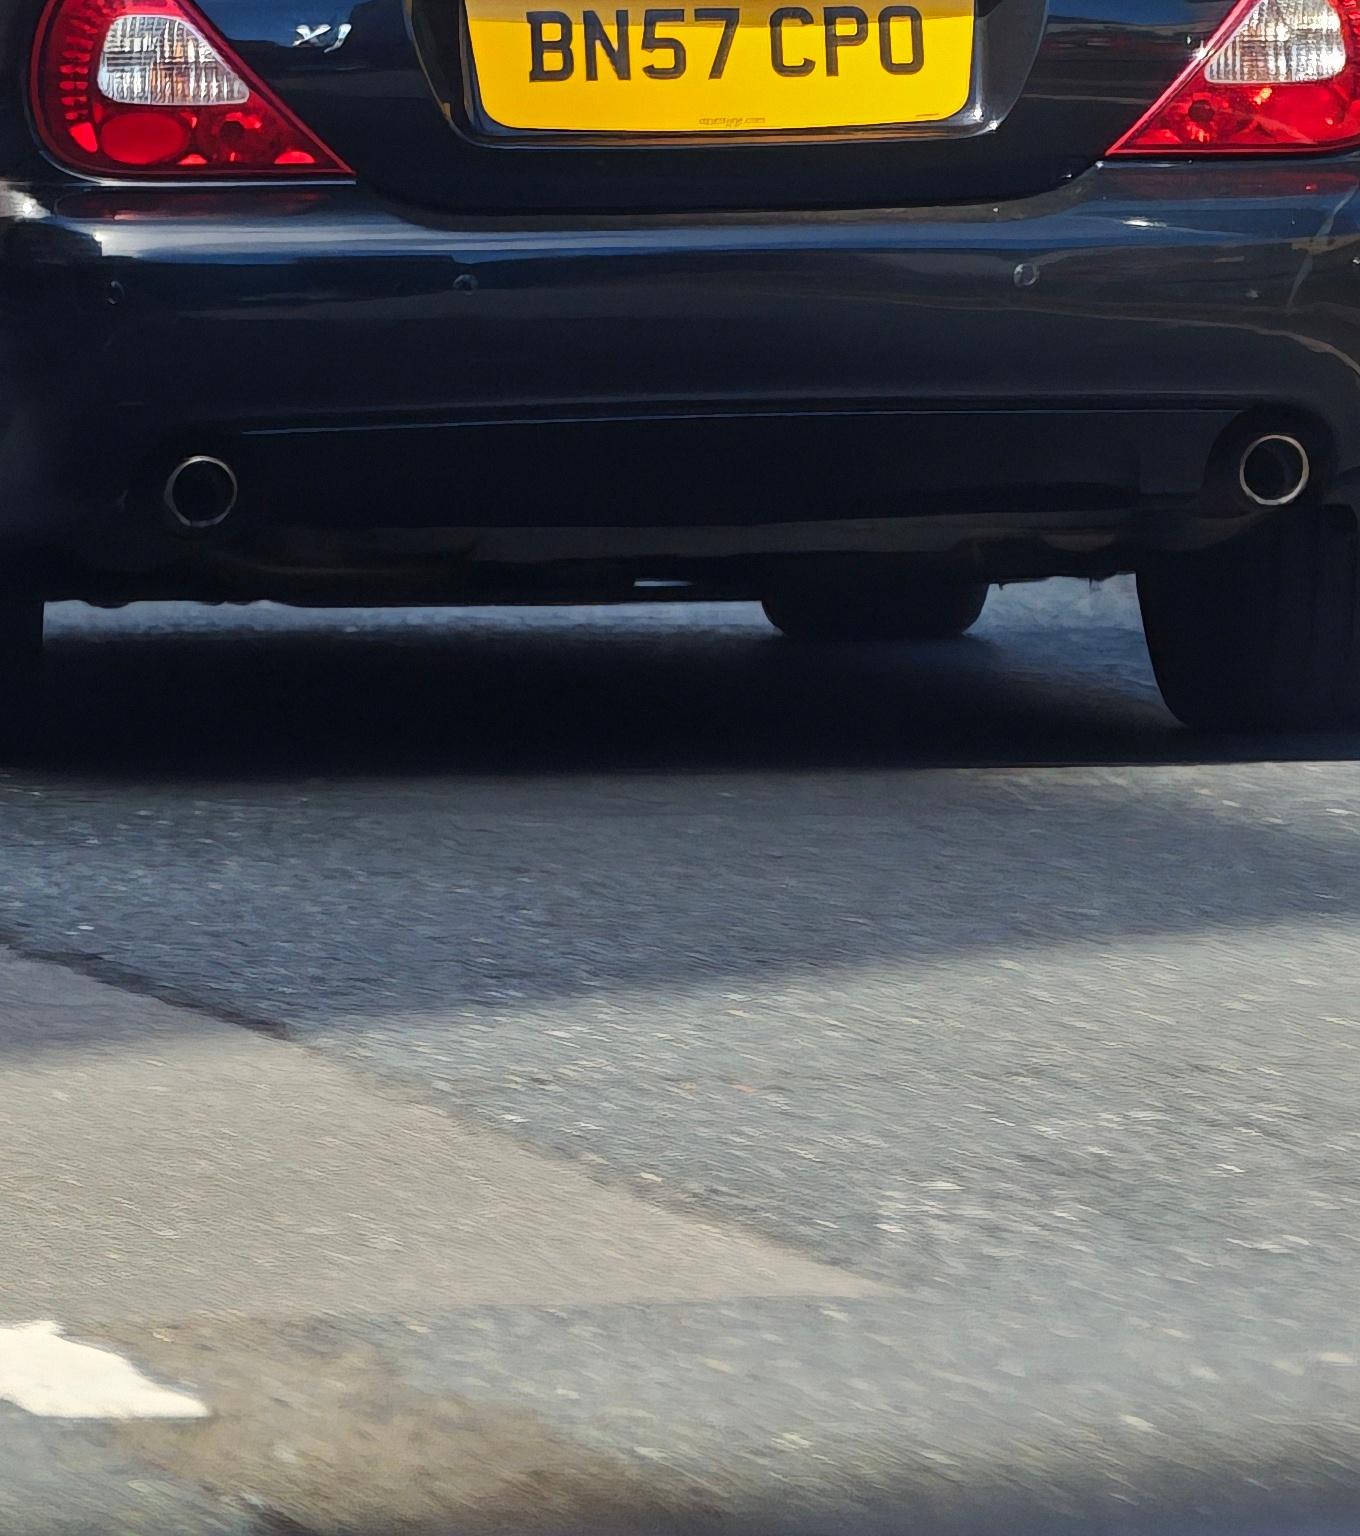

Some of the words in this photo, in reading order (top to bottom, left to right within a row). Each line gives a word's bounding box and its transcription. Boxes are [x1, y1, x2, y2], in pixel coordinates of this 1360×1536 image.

[292, 23, 352, 54] XJ
[525, 7, 740, 83] BN57
[768, 4, 924, 78] CPO
